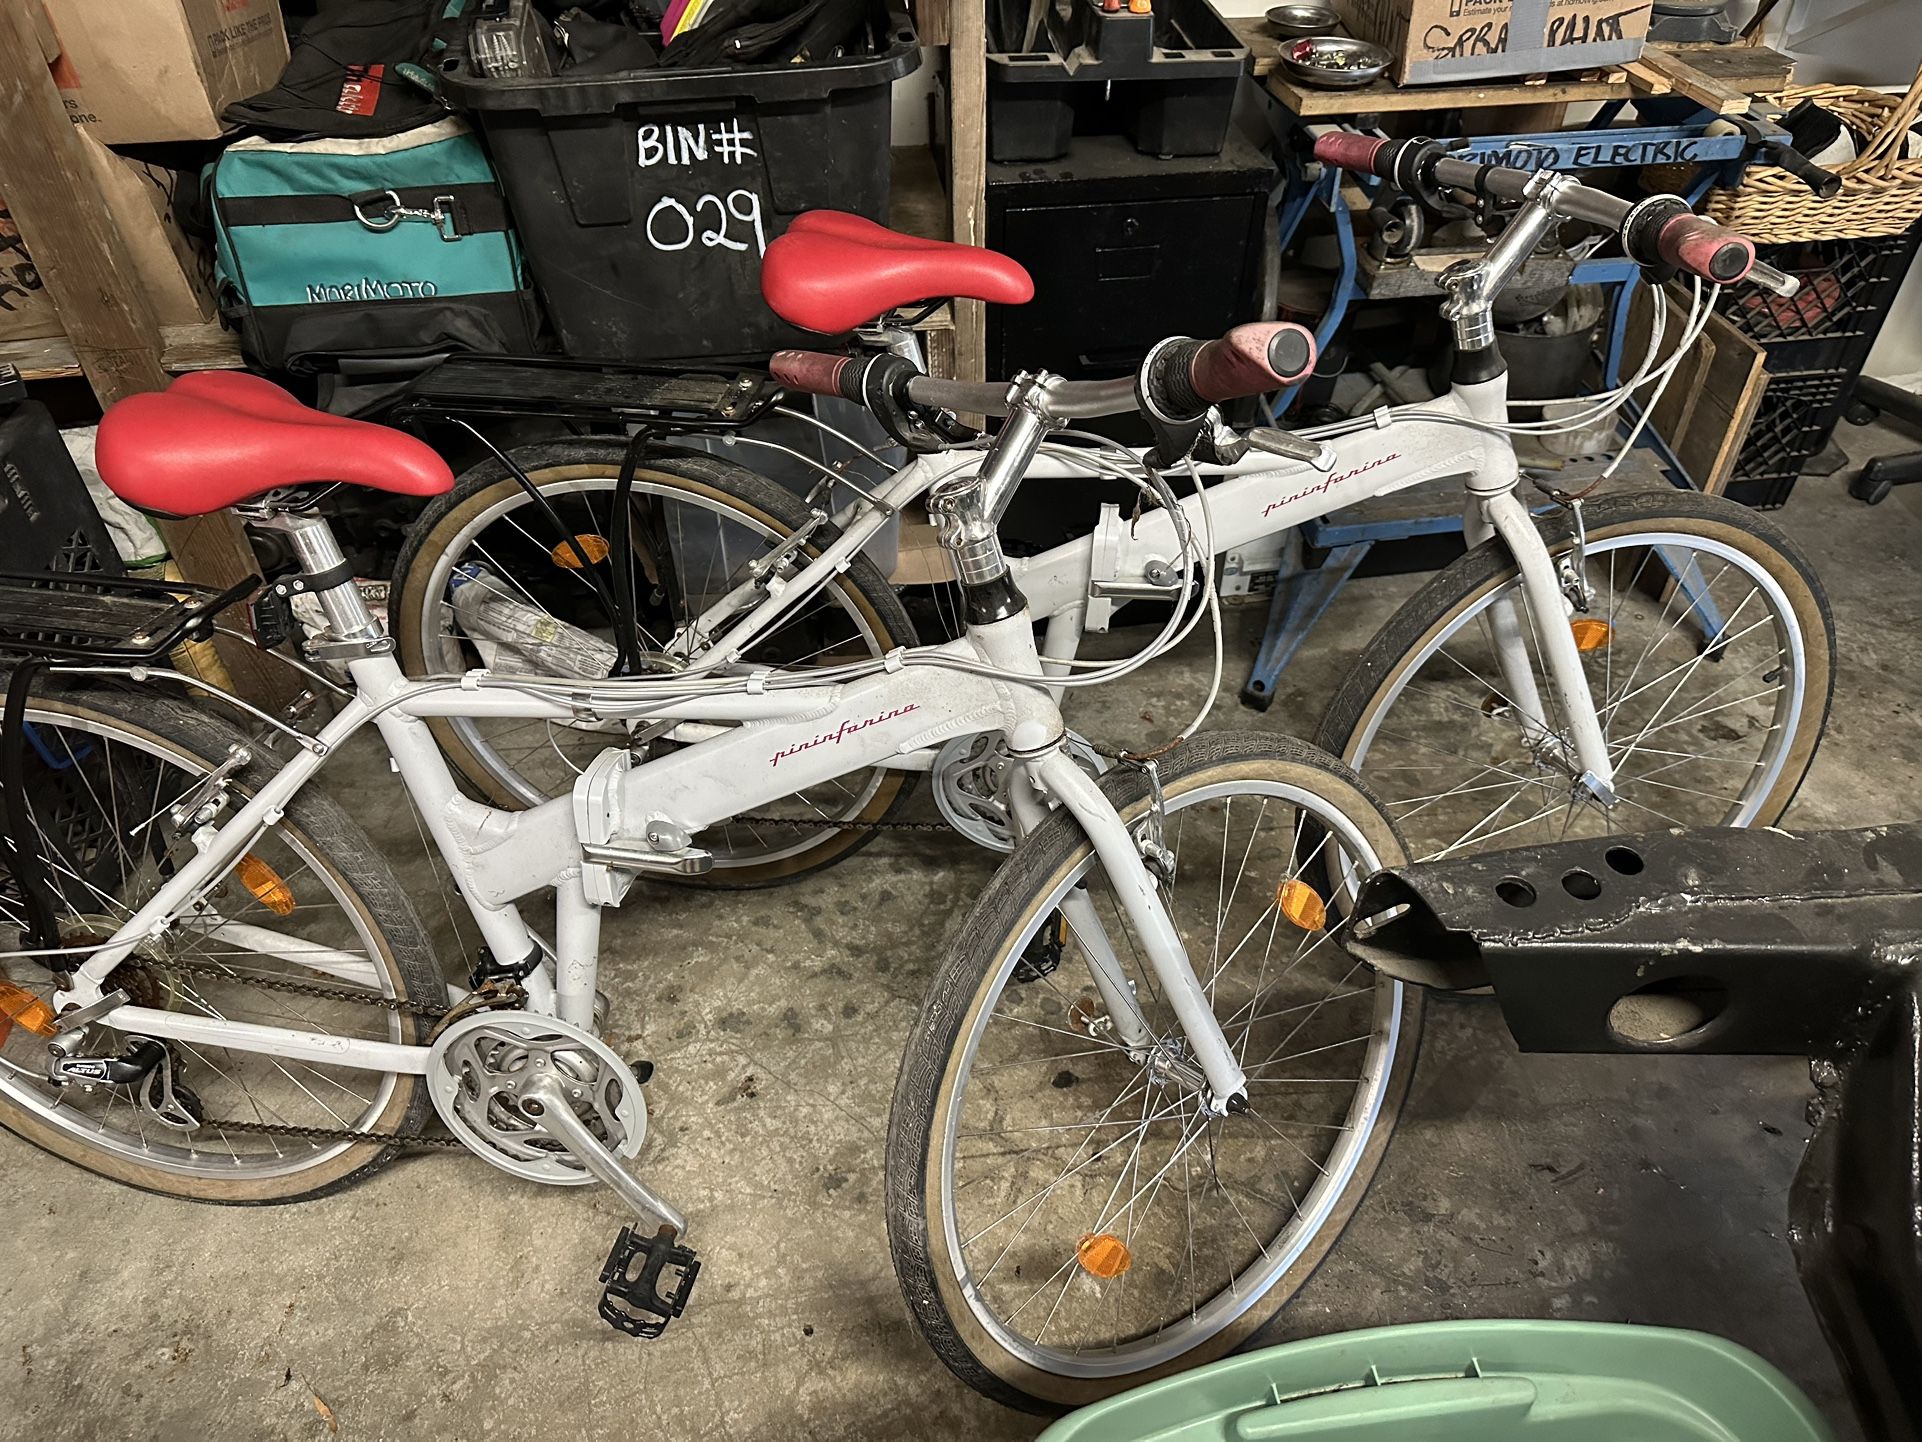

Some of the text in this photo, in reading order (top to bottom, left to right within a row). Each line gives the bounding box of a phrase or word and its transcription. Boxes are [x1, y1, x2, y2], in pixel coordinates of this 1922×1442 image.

[1463, 7, 1492, 16] Estimate
[1493, 6, 1509, 15] your
[1423, 21, 1510, 60] SPRA
[70, 113, 102, 123] one.
[1572, 140, 1698, 168] ELECTRIC
[646, 189, 767, 259] 029
[1261, 452, 1402, 518] pininfarina
[769, 703, 921, 768] pininfarina
[67, 1067, 102, 1075] ALTUS
